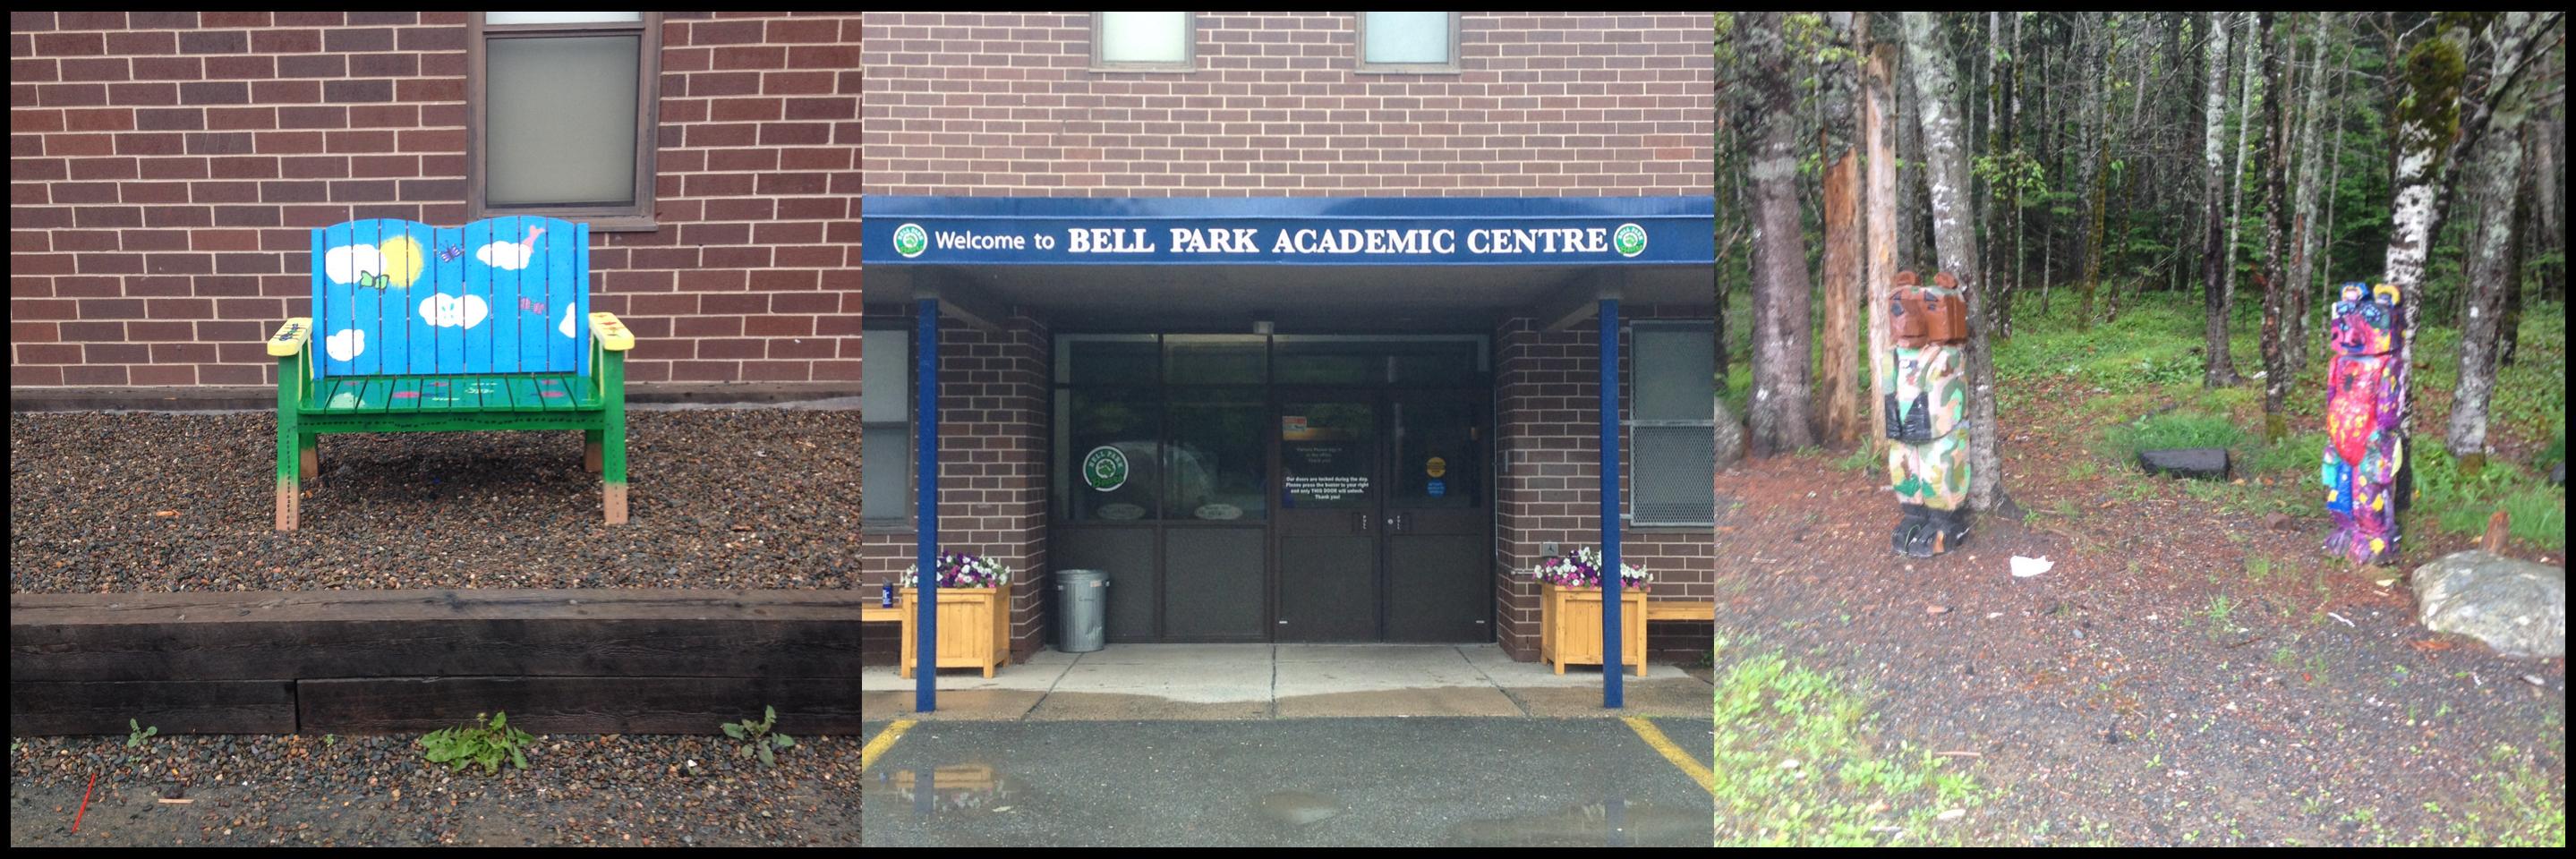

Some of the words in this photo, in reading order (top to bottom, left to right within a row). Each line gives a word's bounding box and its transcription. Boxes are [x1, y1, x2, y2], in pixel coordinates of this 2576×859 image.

[935, 230, 1025, 250] Welcome
[1034, 233, 1055, 250] to
[1068, 228, 1155, 253] BELL
[1170, 228, 1260, 253] PARK
[1272, 228, 1455, 253] ACADEMIC
[1467, 228, 1608, 253] CENTRE
[1088, 450, 1105, 467] BELL
[1106, 450, 1123, 467] PARK
